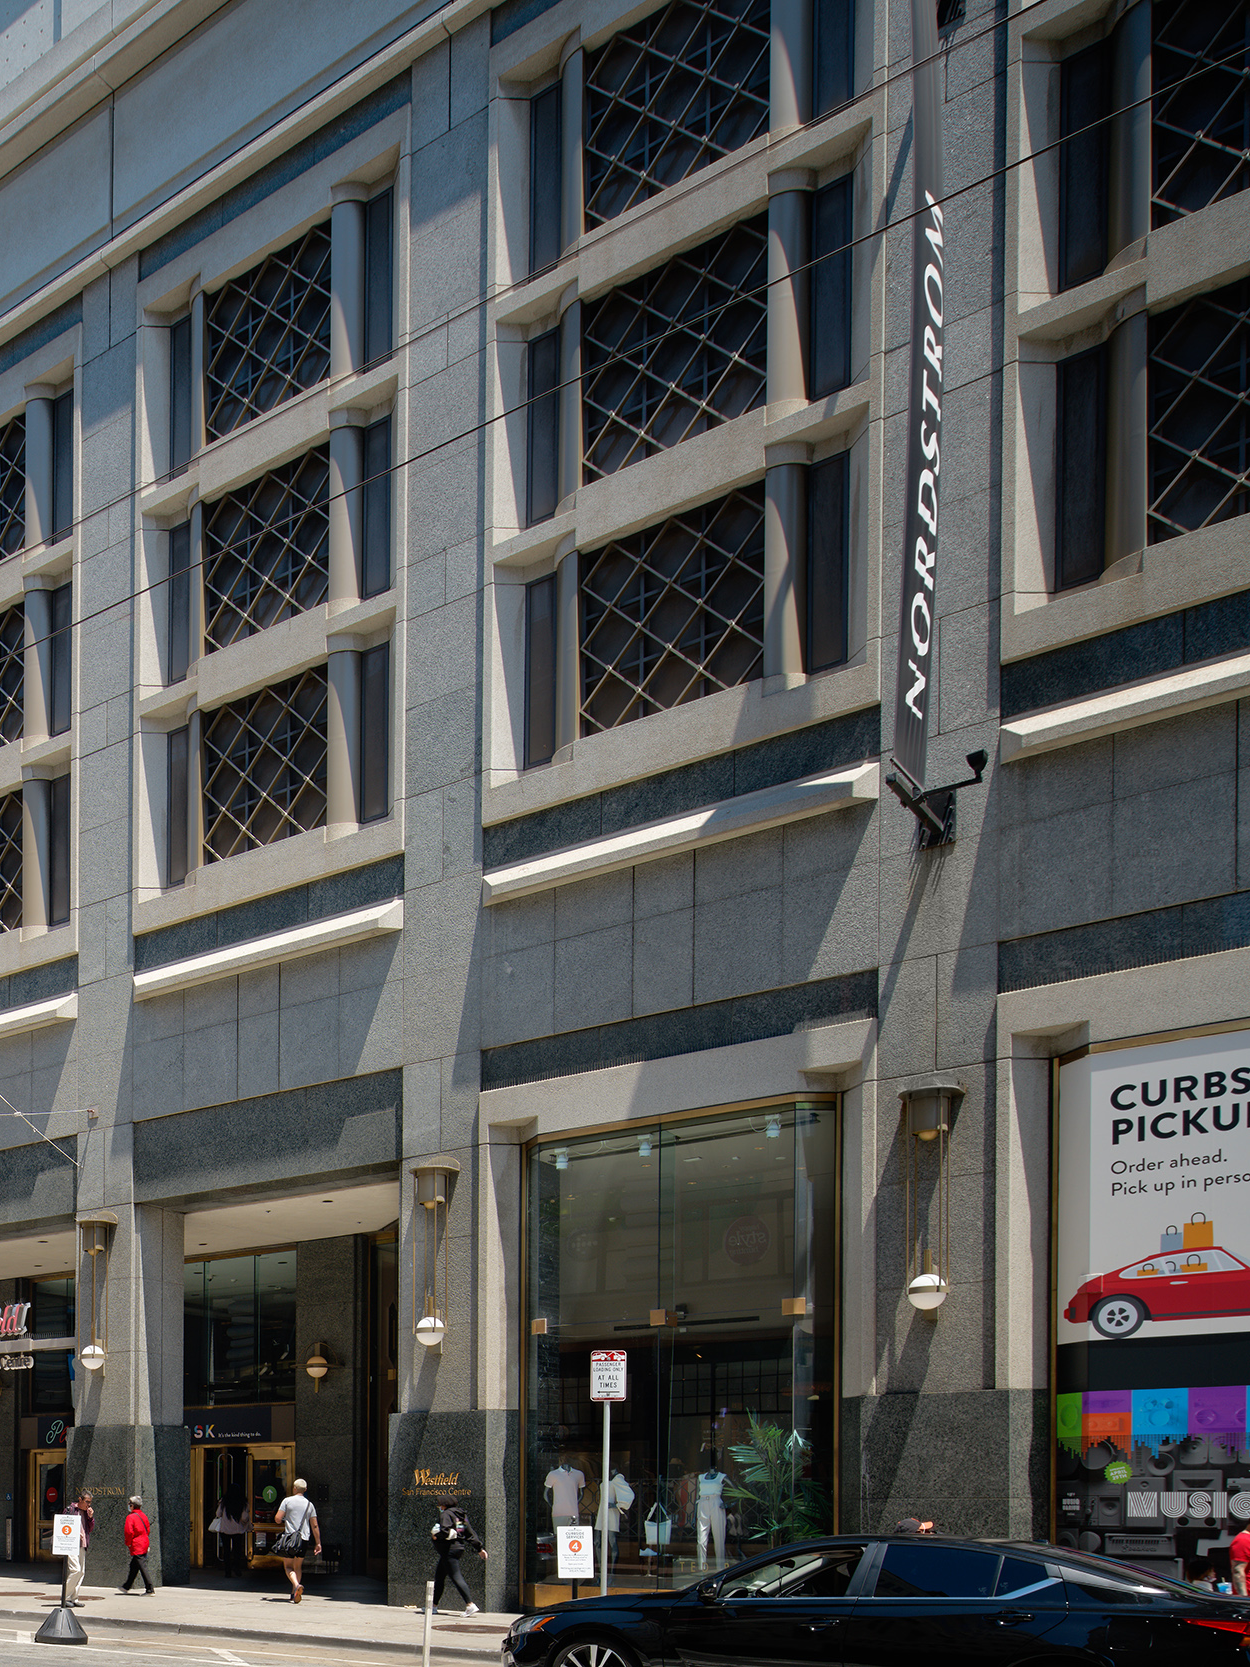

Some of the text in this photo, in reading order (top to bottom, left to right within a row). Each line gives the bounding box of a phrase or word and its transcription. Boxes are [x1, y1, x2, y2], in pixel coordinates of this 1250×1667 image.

[905, 190, 945, 720] NORDSTROM
[1112, 1102, 1250, 1145] PICKU
[1111, 1148, 1228, 1174] Order ahead.
[1112, 1180, 1148, 1196] Pick
[1154, 1182, 1175, 1196] up
[1181, 1175, 1197, 1188] in
[193, 1424, 216, 1439] SK
[413, 1468, 461, 1486] Westfield
[402, 1487, 472, 1496] San Francisco Centre
[64, 1526, 70, 1534] 3
[571, 1541, 579, 1551] 4
[679, 1562, 709, 1573] TED
